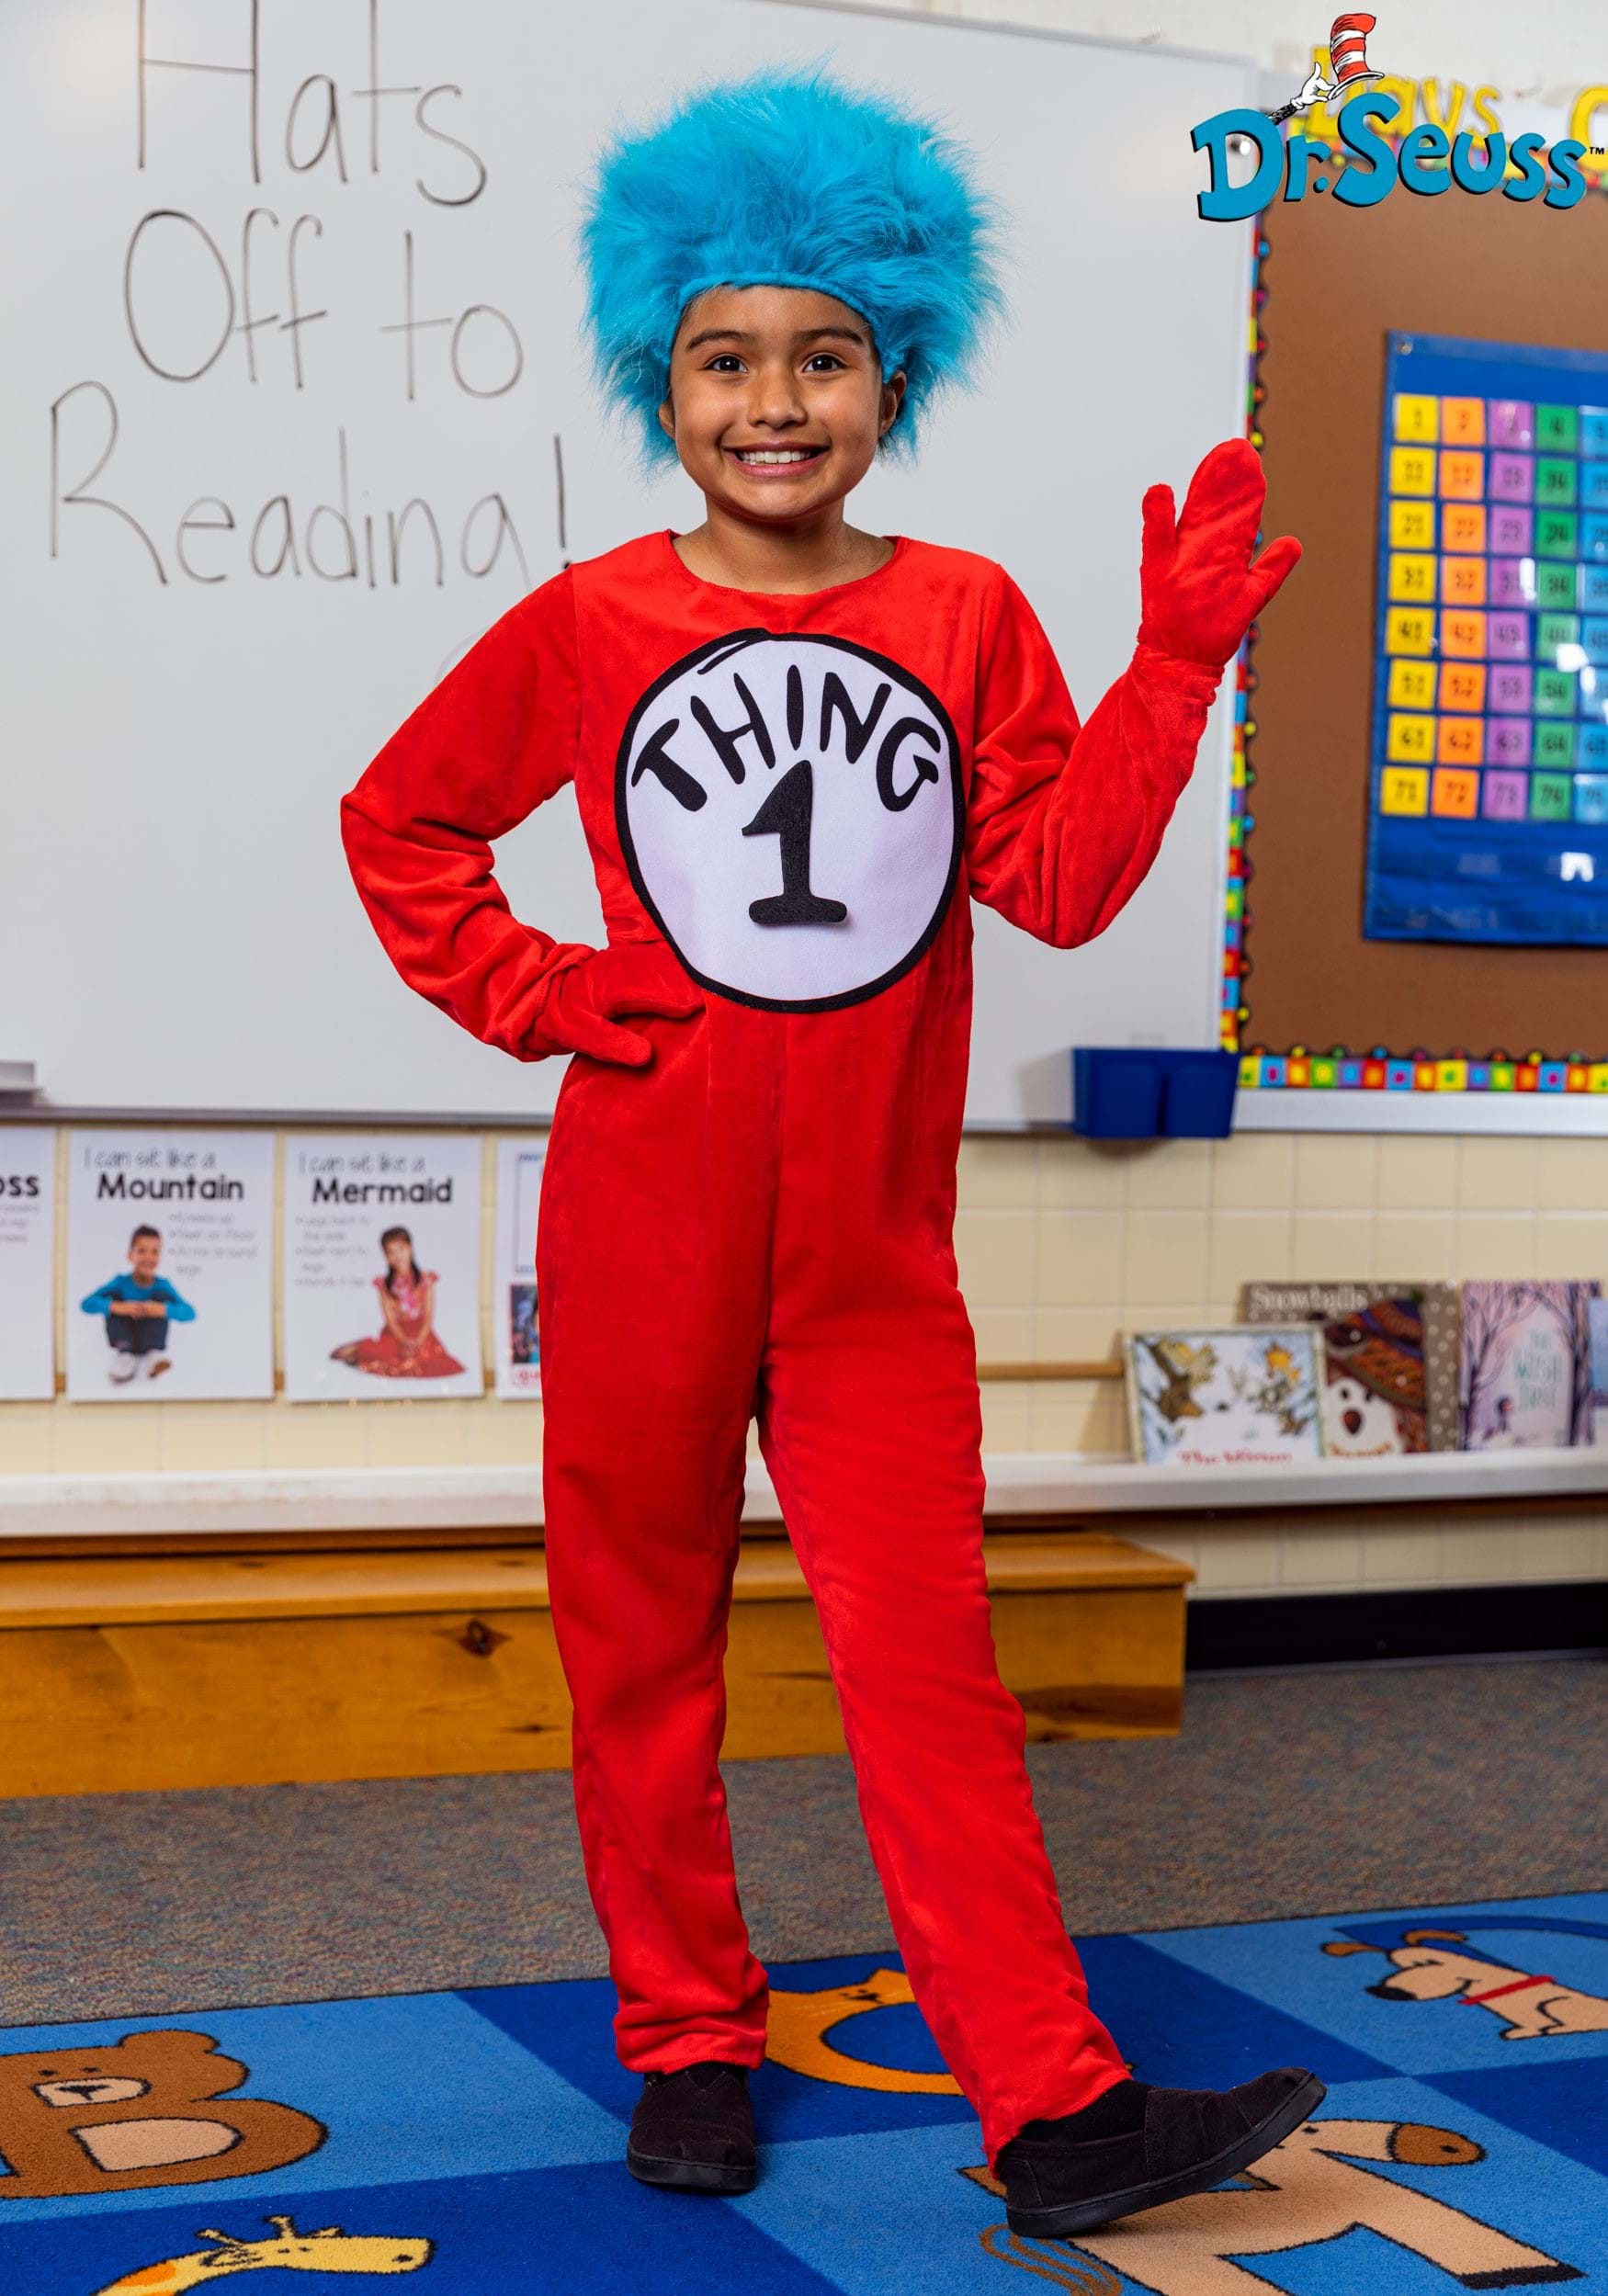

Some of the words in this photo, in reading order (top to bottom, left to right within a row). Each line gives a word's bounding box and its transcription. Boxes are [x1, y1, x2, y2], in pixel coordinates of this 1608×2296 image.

[136, 0, 488, 207] Hats
[123, 208, 328, 390] Off
[379, 230, 524, 402] to
[51, 380, 572, 590] Reading!
[631, 664, 941, 812] THING
[742, 759, 848, 926] 1
[96, 1172, 245, 1200] Mountain
[311, 1177, 453, 1204] Mermaid
